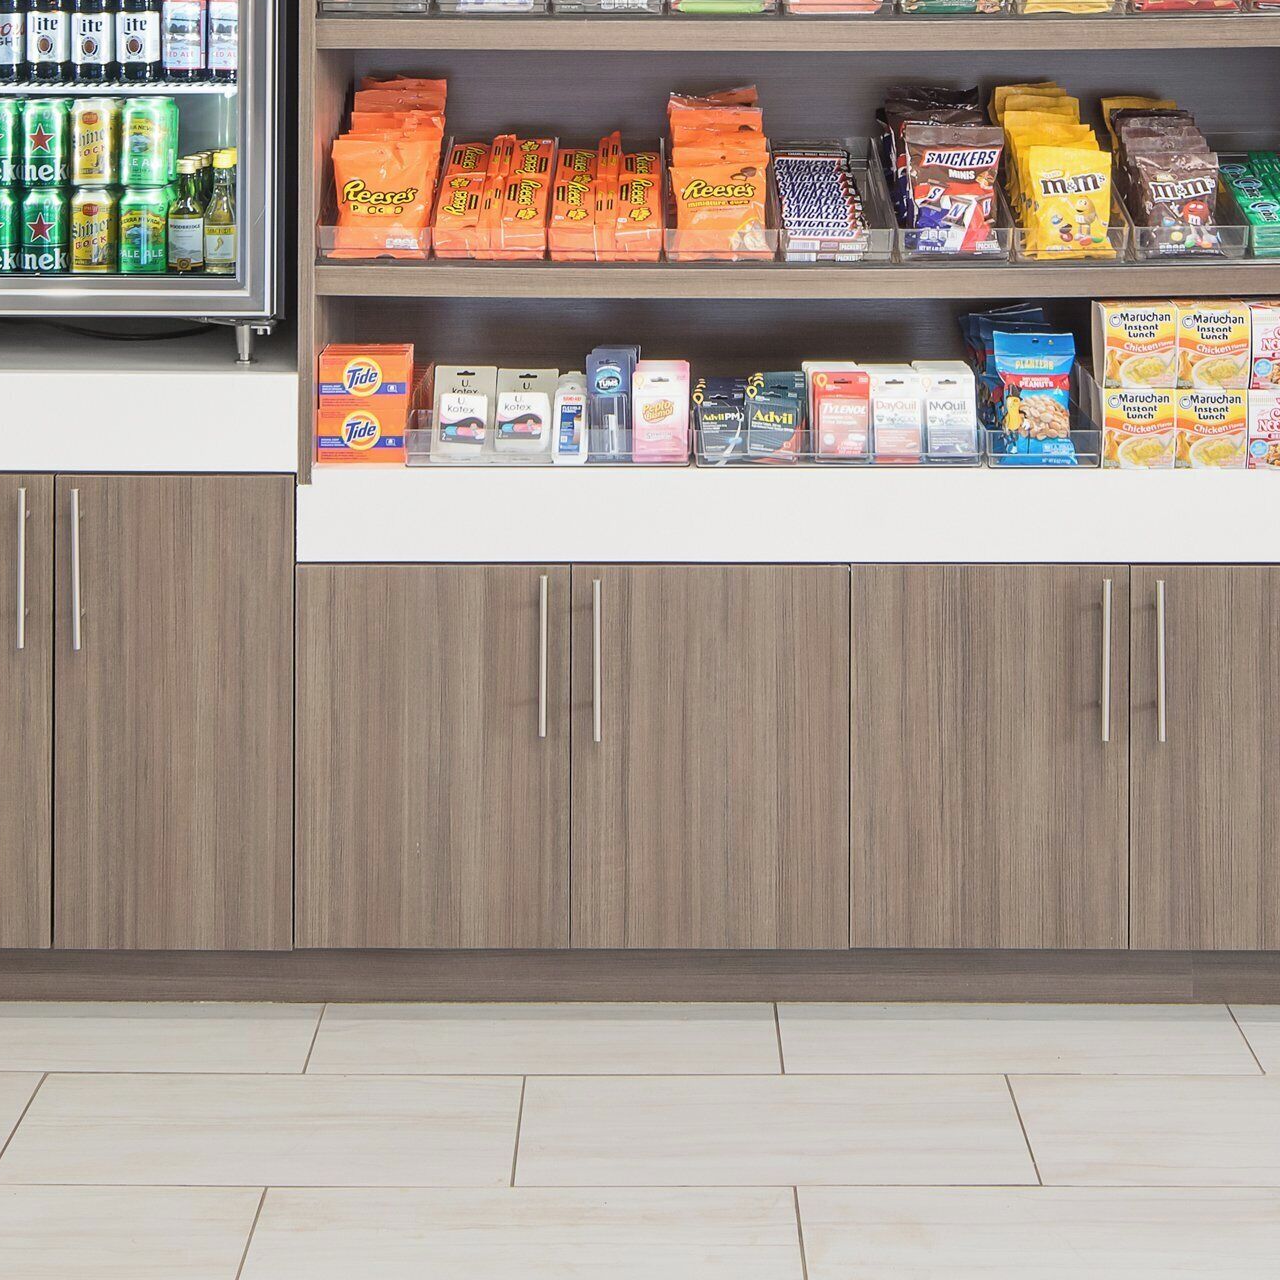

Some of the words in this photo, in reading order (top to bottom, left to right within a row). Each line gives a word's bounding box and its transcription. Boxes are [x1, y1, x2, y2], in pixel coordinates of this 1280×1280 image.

[32, 16, 58, 35] Lite
[80, 19, 103, 36] Lite
[124, 18, 147, 35] Lite
[925, 150, 997, 166] SNICKERS
[948, 169, 976, 180] MINIS
[342, 180, 418, 205] Reese's
[518, 179, 542, 206] Reese's
[682, 179, 757, 200] Reese's
[442, 190, 468, 216] Reese's
[75, 236, 107, 250] BOCK
[1120, 312, 1171, 323] Maruchan
[1192, 313, 1244, 325] Maruchan
[1124, 323, 1159, 332] Instant
[1197, 325, 1232, 334] Instant
[1127, 330, 1156, 338] Lunch
[1200, 332, 1228, 340] Lunch
[1123, 340, 1158, 353] Chicken
[1196, 342, 1231, 354] Chicken
[1015, 360, 1054, 370] PLANTERS
[347, 368, 378, 388] Tide
[598, 379, 619, 389] TUMS
[1019, 380, 1054, 388] PEANUTS
[1119, 393, 1170, 404] Maruchan
[1190, 393, 1242, 405] Maruchan
[447, 403, 475, 414] kotex
[504, 401, 532, 411] kotex
[822, 403, 867, 415] TYLENOL
[875, 401, 917, 411] DayQuil
[1122, 404, 1158, 412] Instant
[1194, 405, 1229, 413] Instant
[702, 413, 725, 421] Advil
[752, 410, 793, 425] Advil
[1126, 411, 1154, 420] Lunch
[1198, 412, 1226, 420] Lunch
[345, 420, 376, 442] Tide
[1122, 422, 1157, 433] Chicken
[1193, 423, 1228, 434] Chicken
